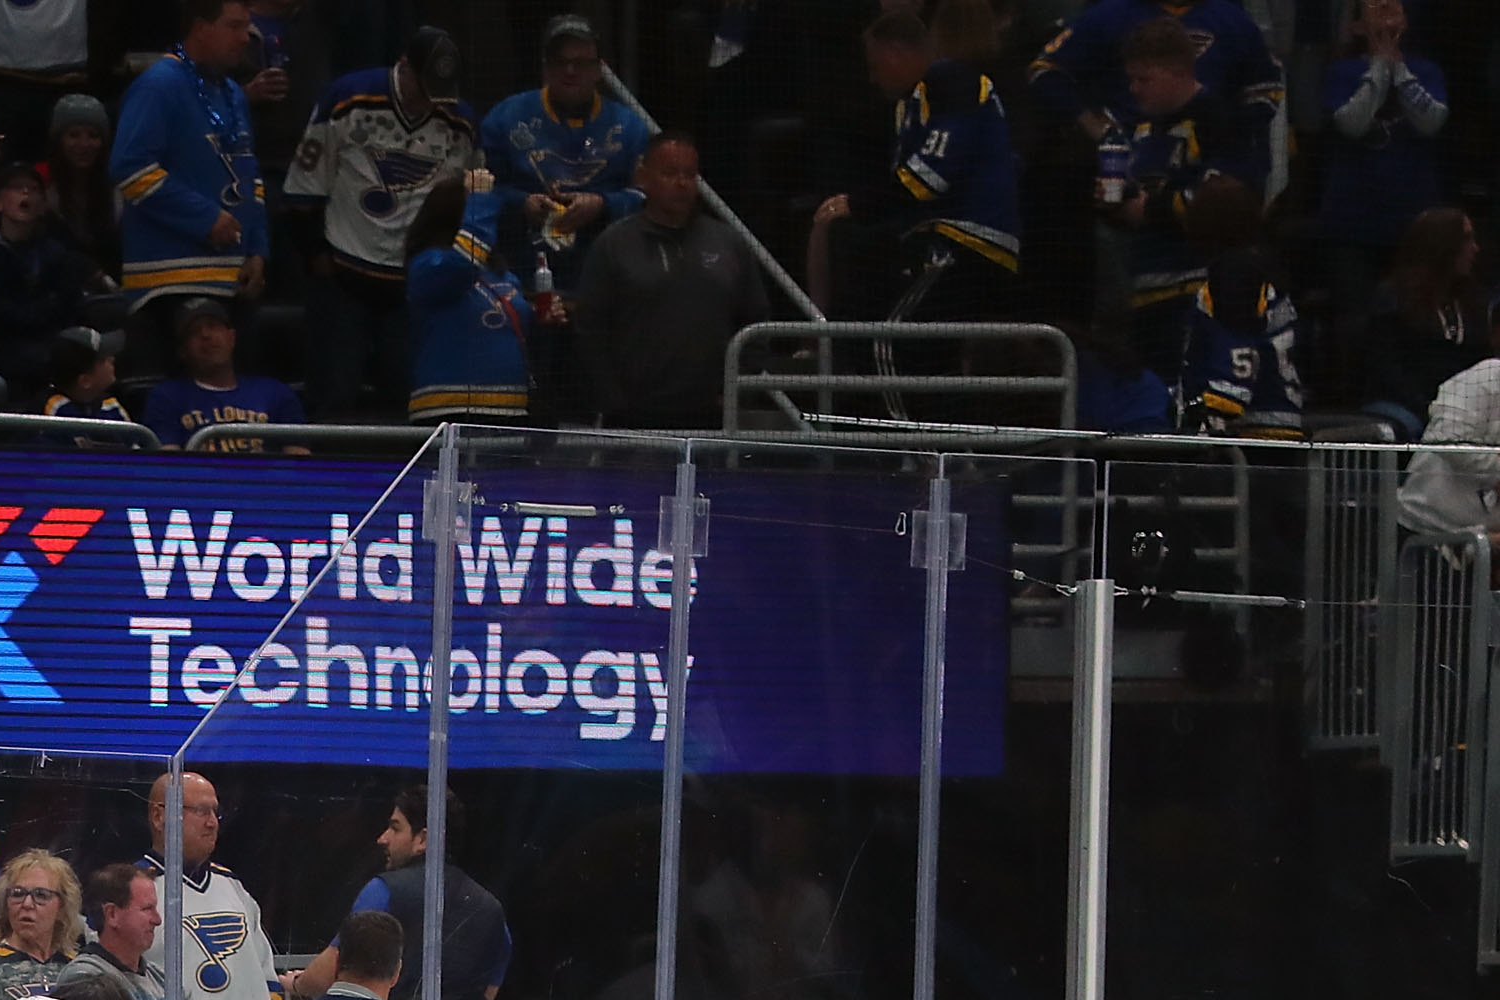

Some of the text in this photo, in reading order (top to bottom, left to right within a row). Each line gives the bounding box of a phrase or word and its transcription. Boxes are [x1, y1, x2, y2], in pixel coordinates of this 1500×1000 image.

[921, 128, 949, 157] 31
[127, 508, 699, 609] World Wide
[128, 616, 695, 742] Technology
